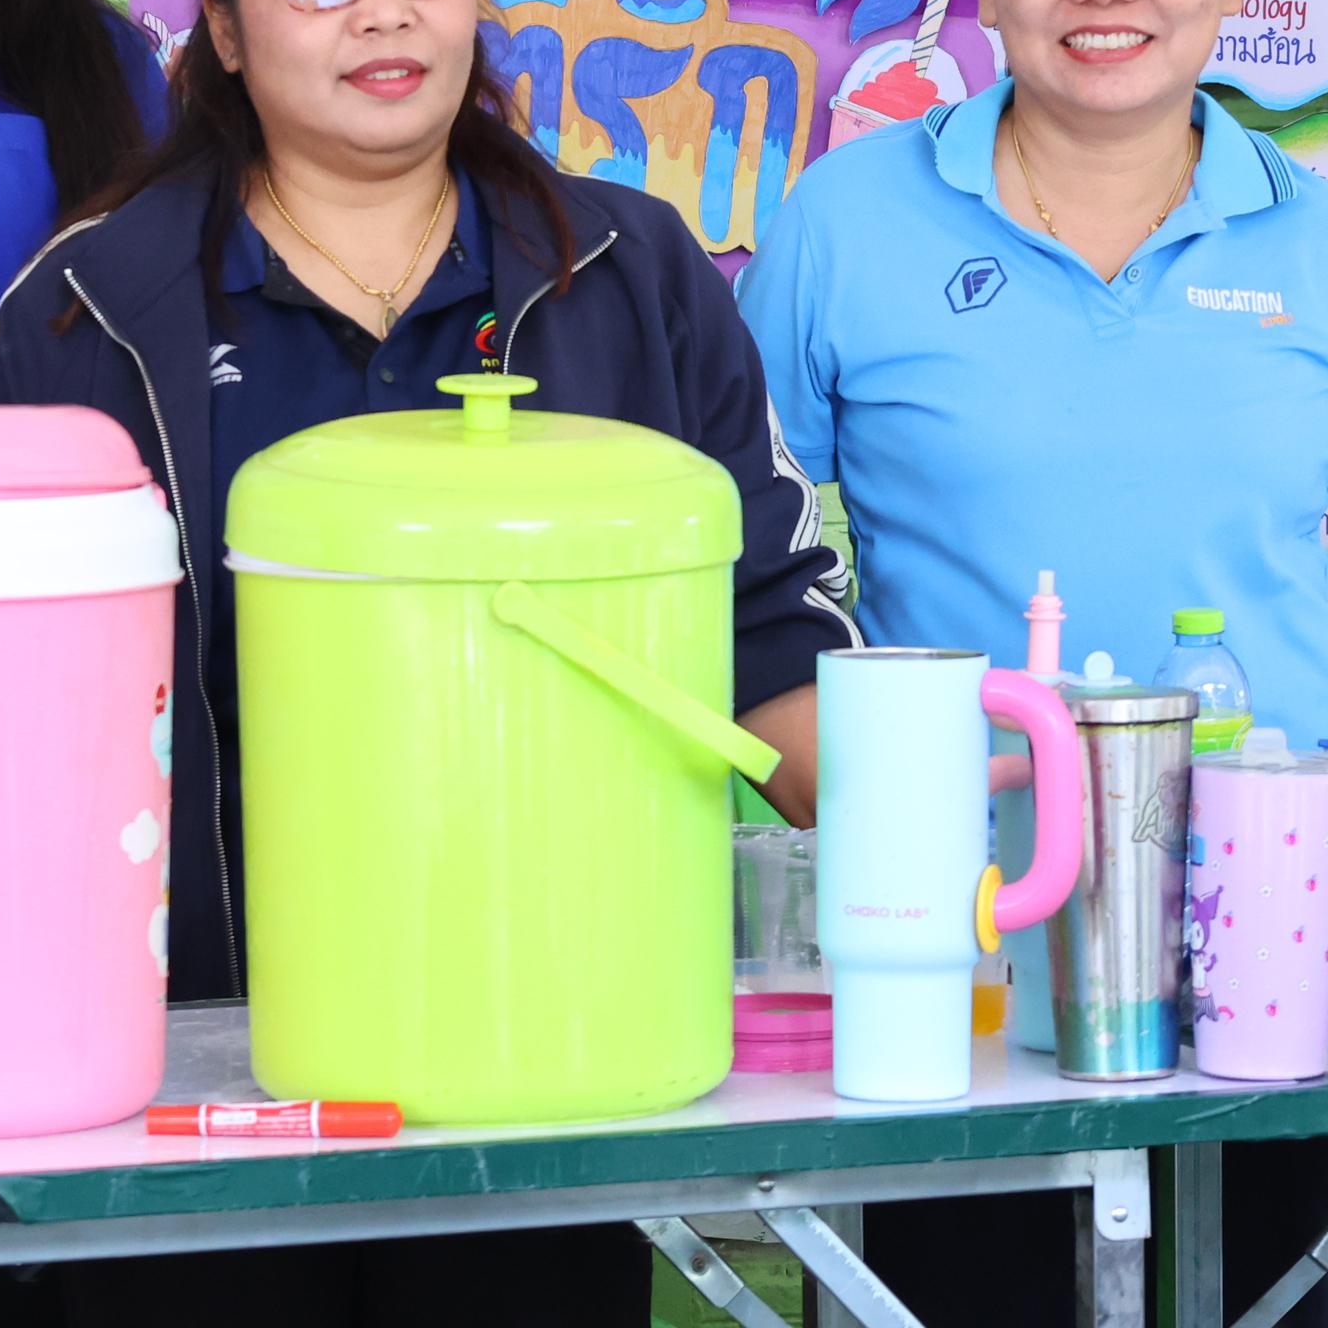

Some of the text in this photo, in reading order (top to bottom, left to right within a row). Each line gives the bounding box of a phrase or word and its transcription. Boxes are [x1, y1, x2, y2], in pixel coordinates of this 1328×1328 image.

[1216, 27, 1317, 66] วามร้อน
[1186, 285, 1283, 314] EDUCATION
